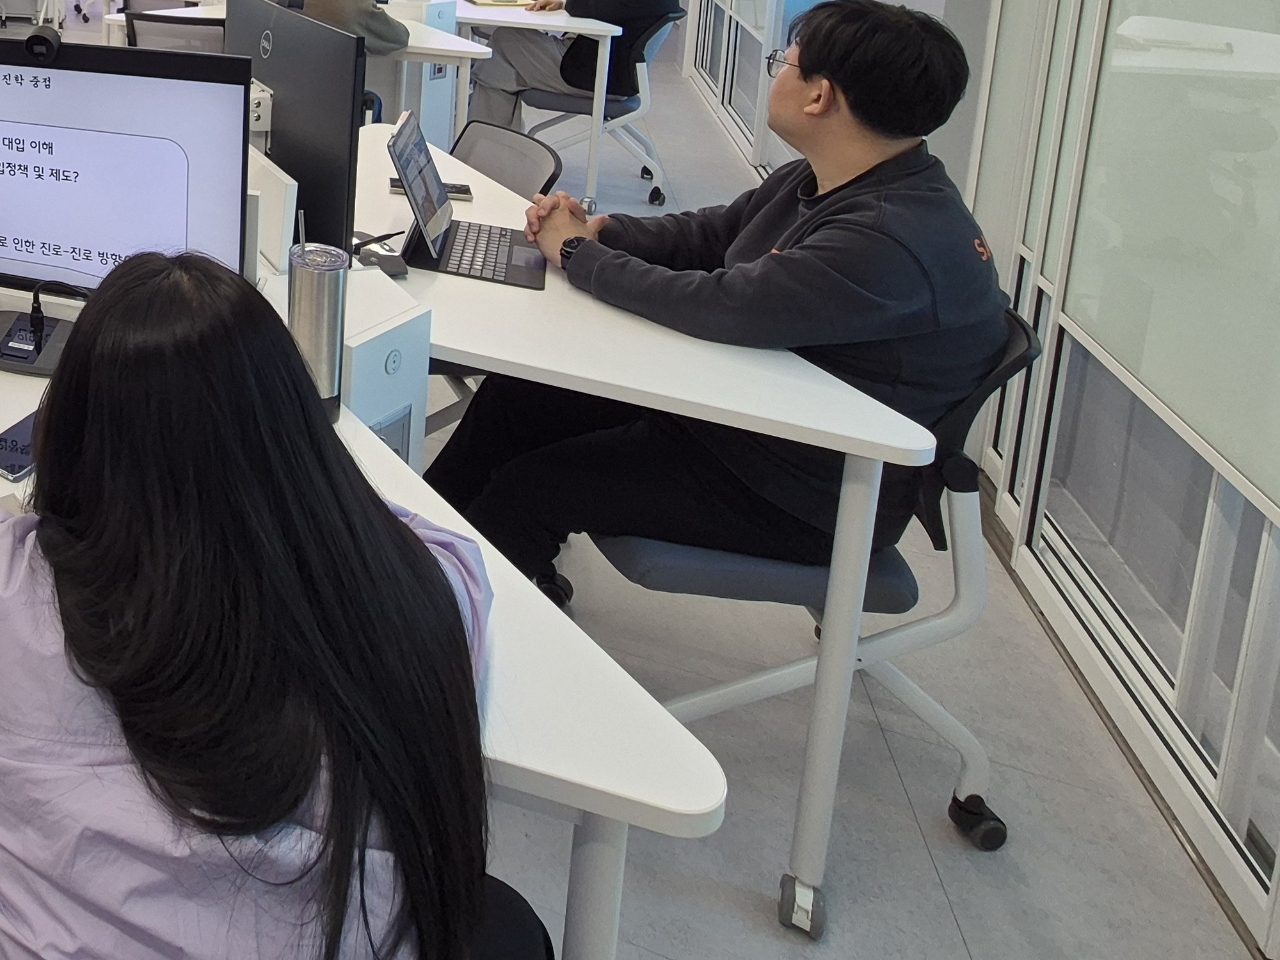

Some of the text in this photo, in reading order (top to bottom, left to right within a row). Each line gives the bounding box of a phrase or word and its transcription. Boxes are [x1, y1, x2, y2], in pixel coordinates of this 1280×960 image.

[1, 72, 25, 86] 진학
[29, 75, 52, 90] 중점
[2, 137, 25, 153] 대입
[29, 140, 54, 156] 이해
[33, 165, 45, 181] 및
[48, 168, 80, 183] 제도?
[12, 237, 36, 253] 인한
[39, 241, 94, 262] 진로-진로
